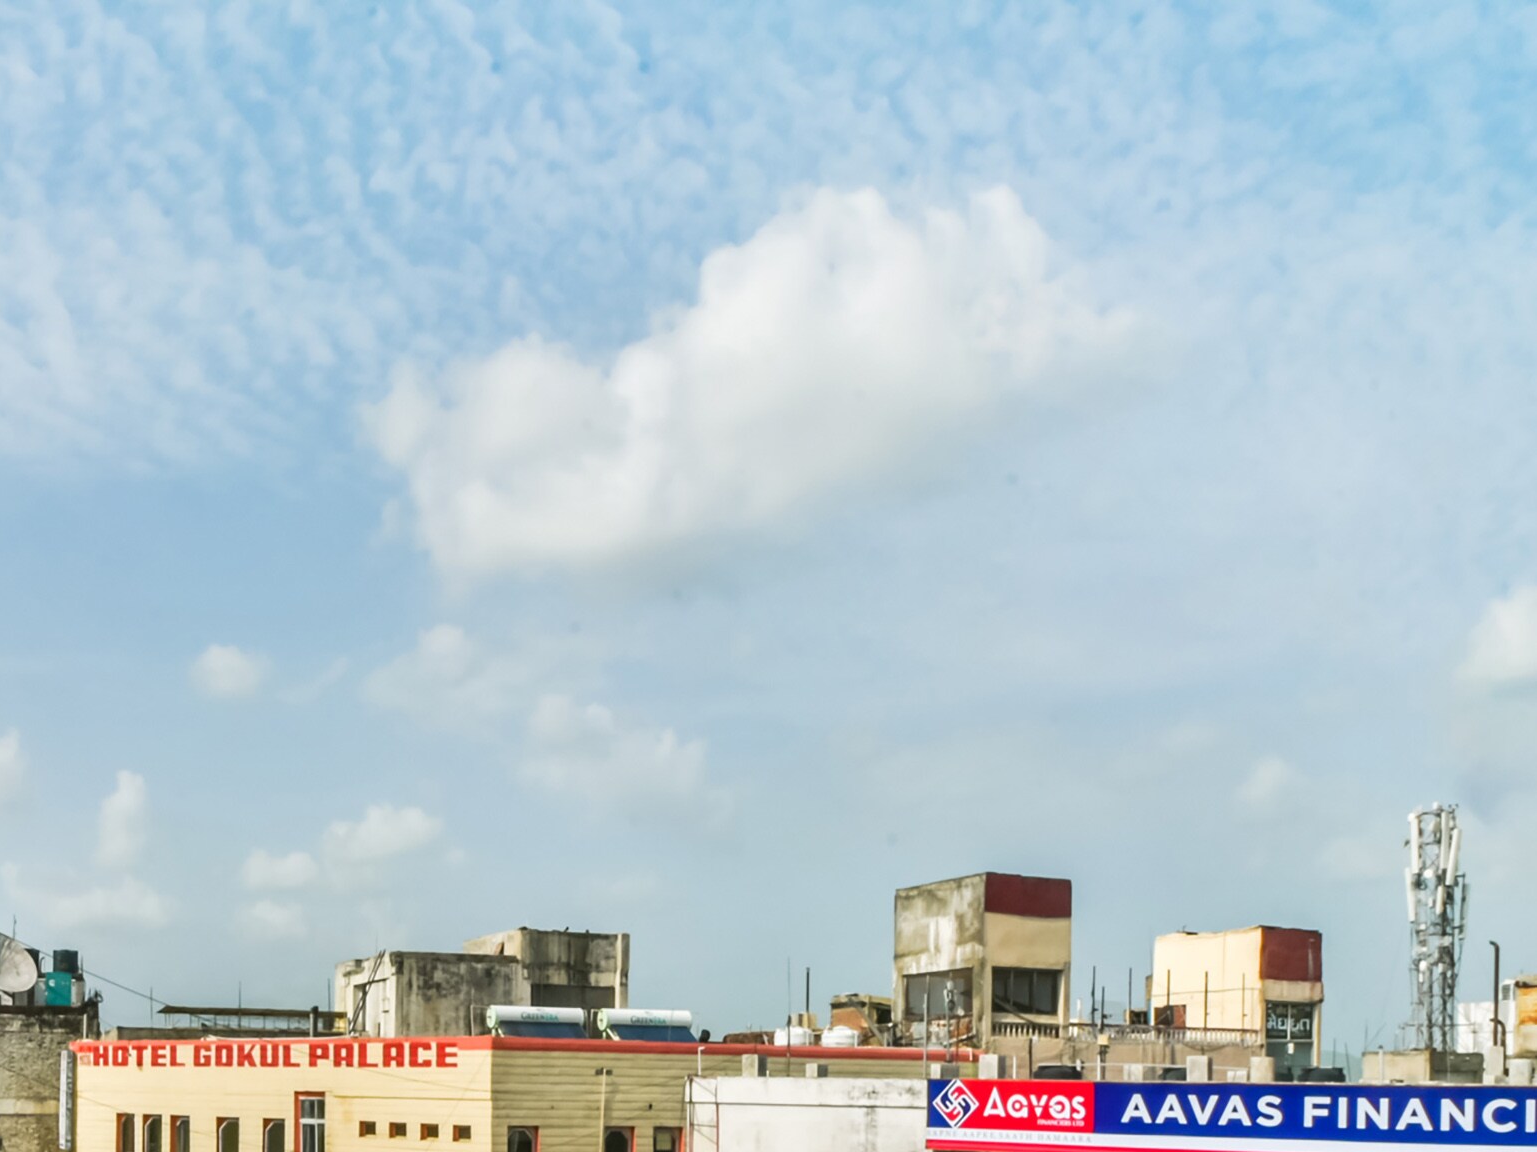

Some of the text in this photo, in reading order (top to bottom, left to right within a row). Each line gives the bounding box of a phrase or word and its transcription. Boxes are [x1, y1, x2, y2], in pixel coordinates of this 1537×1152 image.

[93, 1042, 458, 1068] HOTEL GOKUL PALACE
[982, 1086, 1087, 1120] Aavas
[1120, 1093, 1536, 1133] AAVAS FINANCI
